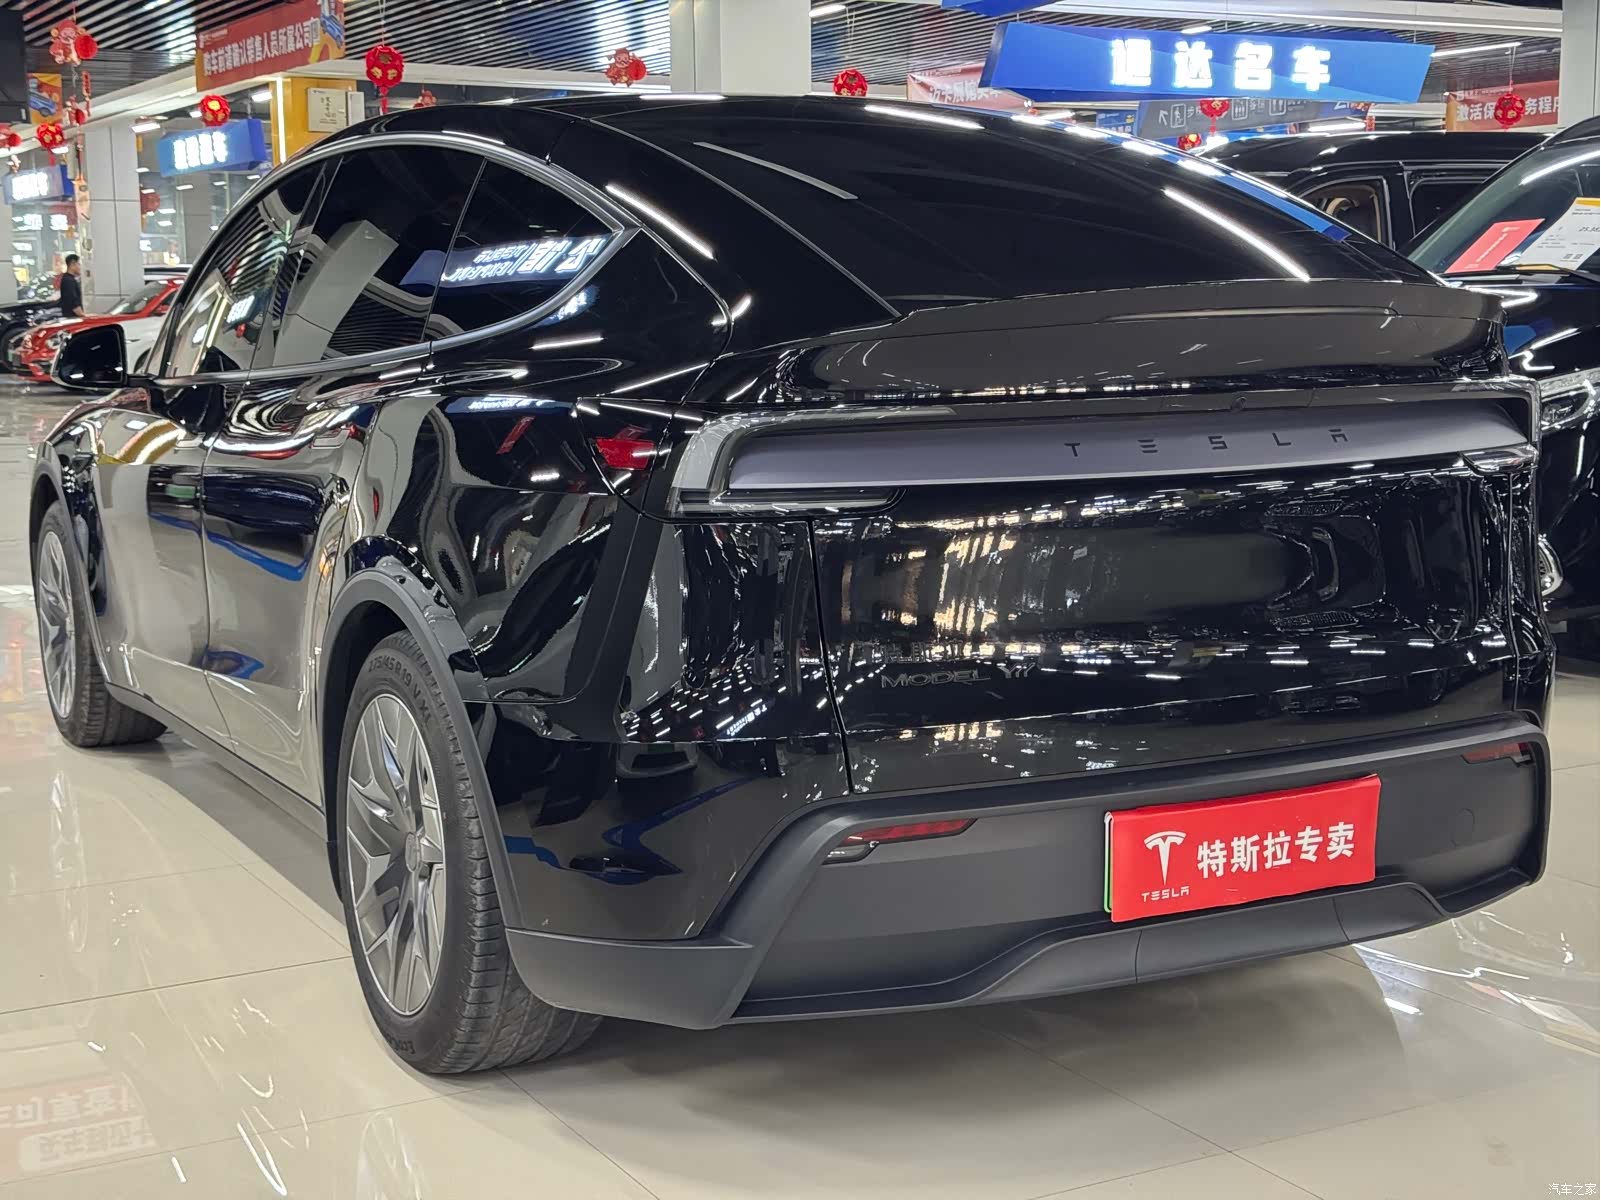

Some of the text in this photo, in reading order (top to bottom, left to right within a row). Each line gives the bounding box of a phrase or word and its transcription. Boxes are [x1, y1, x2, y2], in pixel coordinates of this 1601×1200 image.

[1111, 38, 1331, 91] 通达名车
[1456, 95, 1560, 121] 激活保务程
[1063, 428, 1349, 458] TESLA
[881, 669, 987, 689] MODEL
[1196, 821, 1355, 879] 特斯拉专卖
[1141, 885, 1190, 903] TESLA
